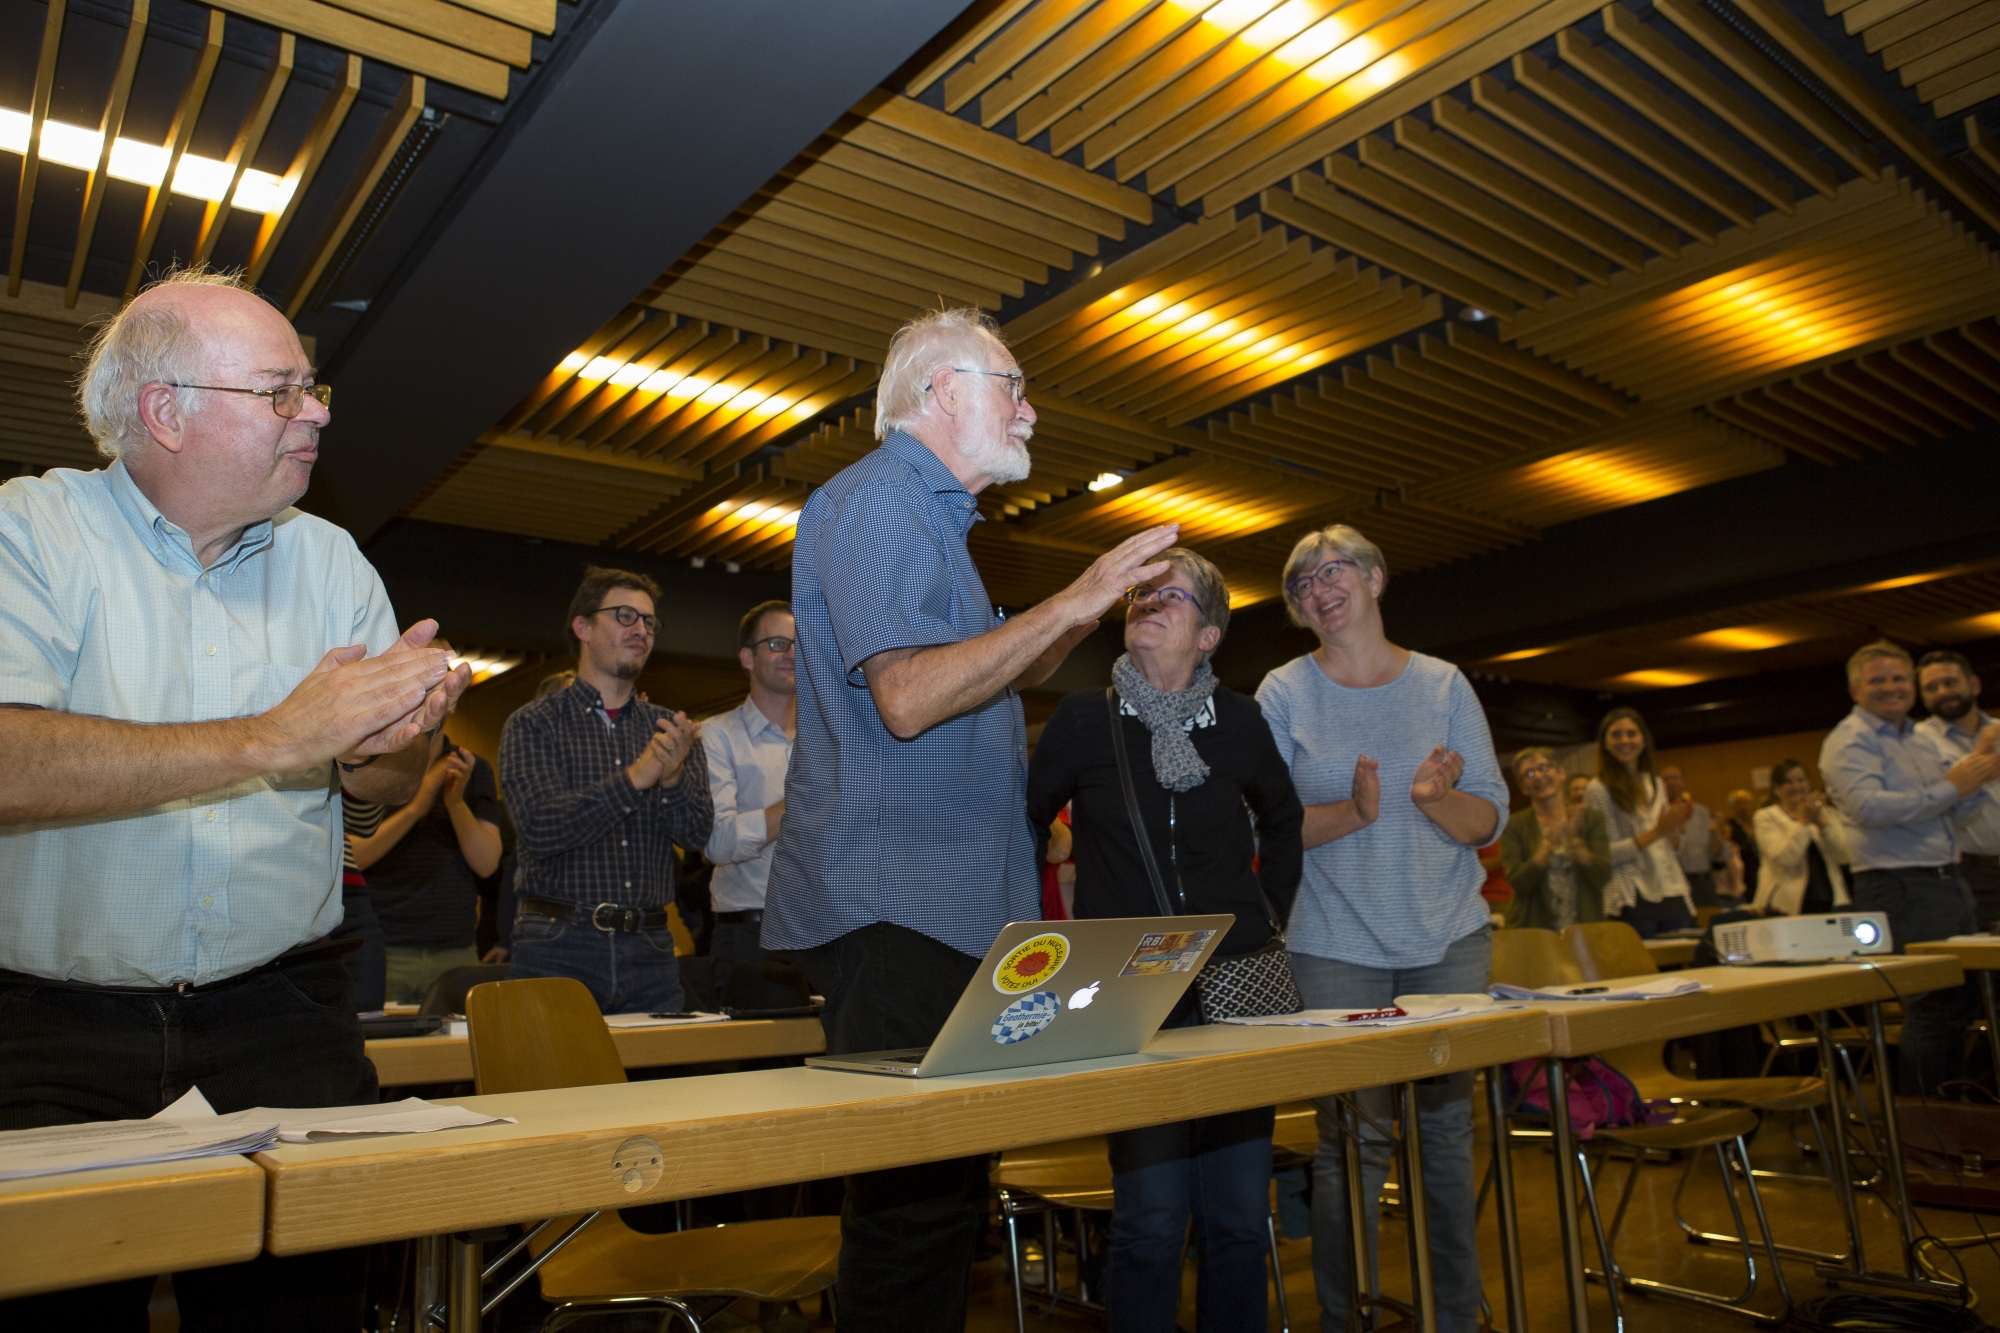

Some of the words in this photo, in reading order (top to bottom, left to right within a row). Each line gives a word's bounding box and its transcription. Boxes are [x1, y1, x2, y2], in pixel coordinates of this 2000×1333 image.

[1003, 945, 1031, 970] SORTIE
[1033, 939, 1046, 948] DU
[1001, 975, 1021, 988] VOTEZ
[1021, 978, 1038, 988] OUI
[1016, 1021, 1025, 1030] ja
[1024, 1020, 1042, 1028] bitte!
